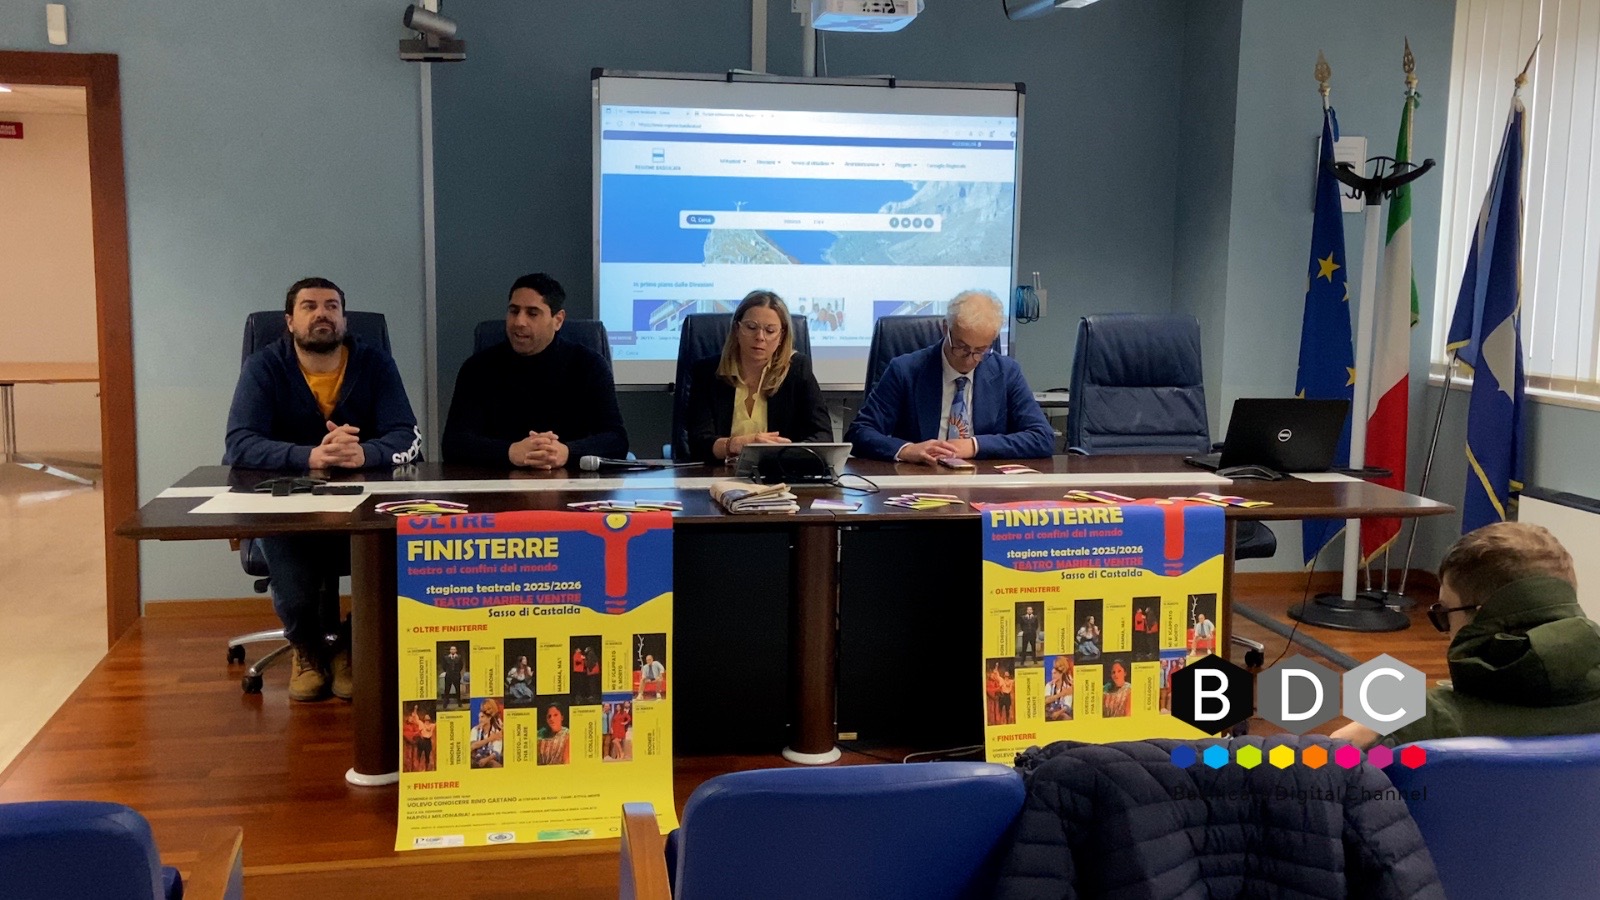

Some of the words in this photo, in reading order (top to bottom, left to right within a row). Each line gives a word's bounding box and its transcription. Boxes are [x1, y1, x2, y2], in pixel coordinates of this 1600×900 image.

[409, 514, 496, 530] OLTRE
[990, 506, 1124, 528] FINISTERRE
[992, 531, 1022, 541] teatro
[1024, 530, 1034, 540] ai
[1036, 529, 1070, 539] confini
[1072, 528, 1087, 538] del
[1090, 528, 1123, 538] mondo
[407, 537, 560, 561] FINISTERRE
[1007, 548, 1048, 560] stagione
[1050, 546, 1090, 557] teatrale
[1092, 546, 1144, 556] 2025/2026
[408, 565, 442, 576] teatro
[446, 564, 458, 574] ai
[460, 563, 497, 574] confini
[500, 562, 517, 573] del
[520, 562, 558, 572] mondo
[1013, 561, 1052, 570] TEATRO
[1056, 560, 1100, 569] MARIELE
[1104, 557, 1143, 567] VENTRE
[1061, 570, 1086, 580] Sasso
[1088, 569, 1098, 579] di
[1100, 568, 1143, 578] Castalda
[426, 584, 474, 596] stagione
[476, 582, 521, 594] teatrale
[524, 580, 582, 592] 2025/2026
[434, 597, 480, 608] TEATRO
[483, 595, 533, 606] MARIELE
[536, 594, 582, 605] VENTRE
[488, 608, 516, 618] Sasso
[519, 607, 530, 617] di
[533, 605, 581, 616] Castalda
[442, 624, 488, 632] FINISTERRE
[997, 733, 1036, 742] FINISTERRE
[414, 781, 460, 790] FINISTERRE
